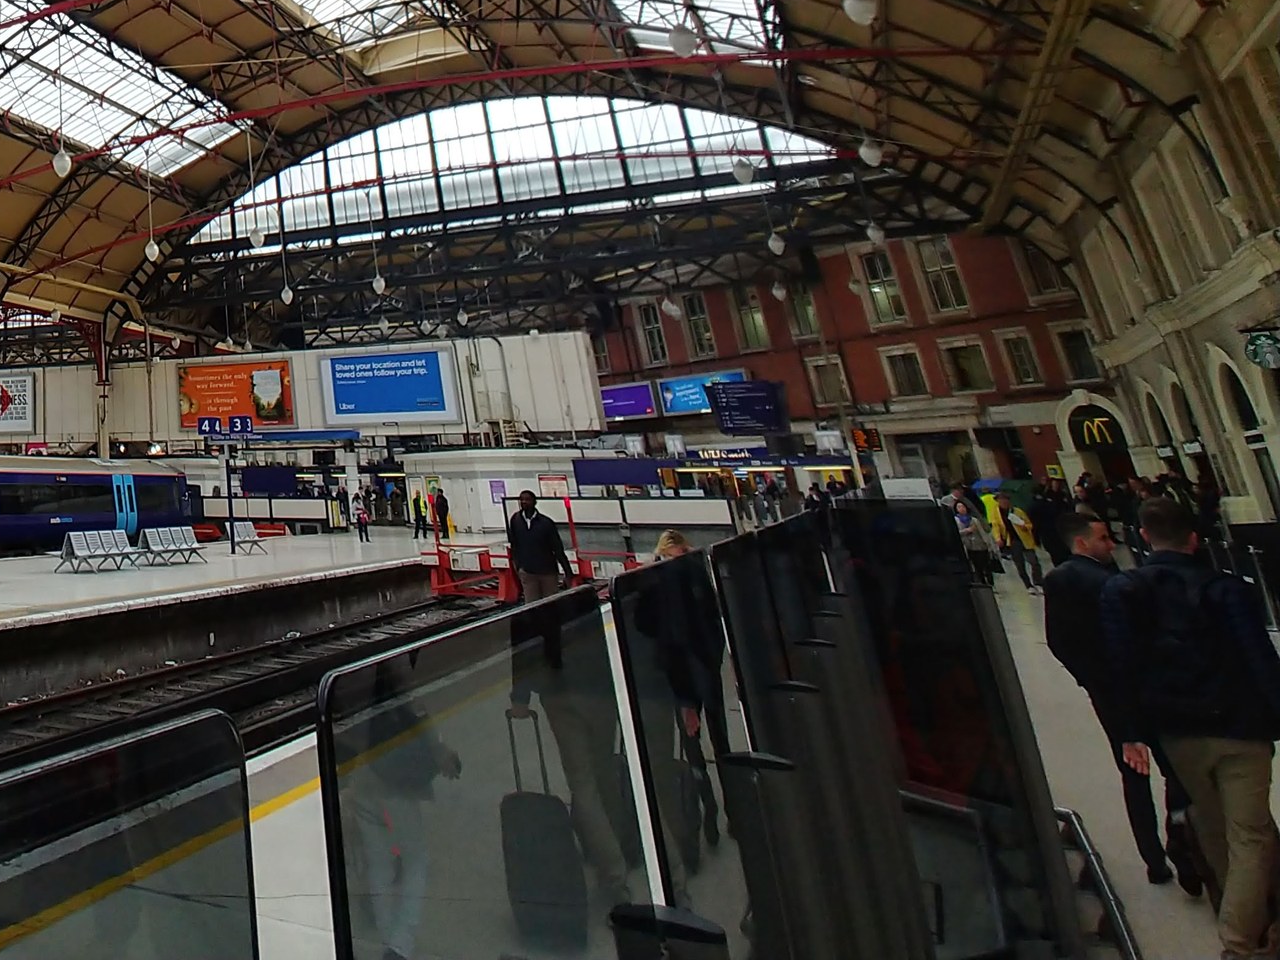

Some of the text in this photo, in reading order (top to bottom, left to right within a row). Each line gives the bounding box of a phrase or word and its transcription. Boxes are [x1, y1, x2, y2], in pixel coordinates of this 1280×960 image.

[335, 363, 354, 371] Share
[355, 363, 371, 371] your
[372, 360, 400, 369] location
[401, 359, 415, 367] and
[234, 372, 247, 381] only
[335, 371, 355, 379] loved
[374, 369, 395, 377] follow
[396, 368, 412, 377] your
[413, 367, 428, 375] trip.
[202, 419, 220, 432] 4 4
[233, 418, 251, 431] 3 3
